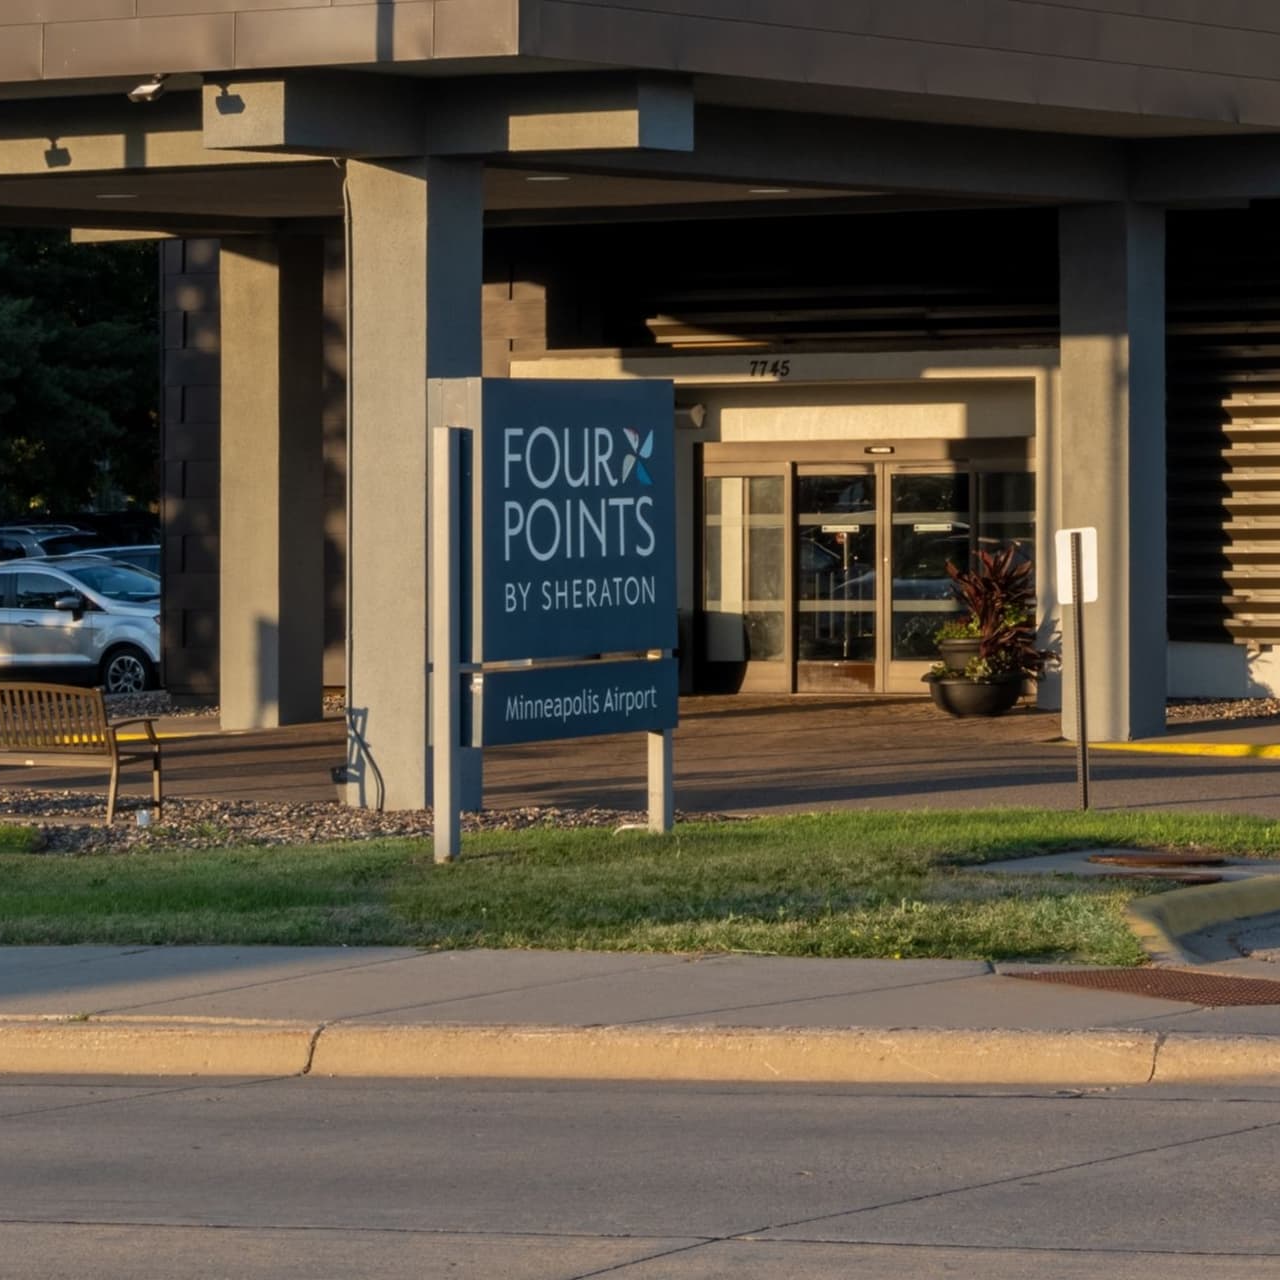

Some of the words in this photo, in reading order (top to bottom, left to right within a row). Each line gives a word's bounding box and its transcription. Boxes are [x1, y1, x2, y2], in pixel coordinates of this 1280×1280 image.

[750, 360, 790, 377] 7745
[504, 426, 618, 489] FOUR
[504, 496, 655, 561] POINTS
[505, 582, 531, 612] BY
[542, 576, 655, 610] SHERATON
[505, 688, 600, 723] Minneapolis
[603, 685, 658, 717] Airport
